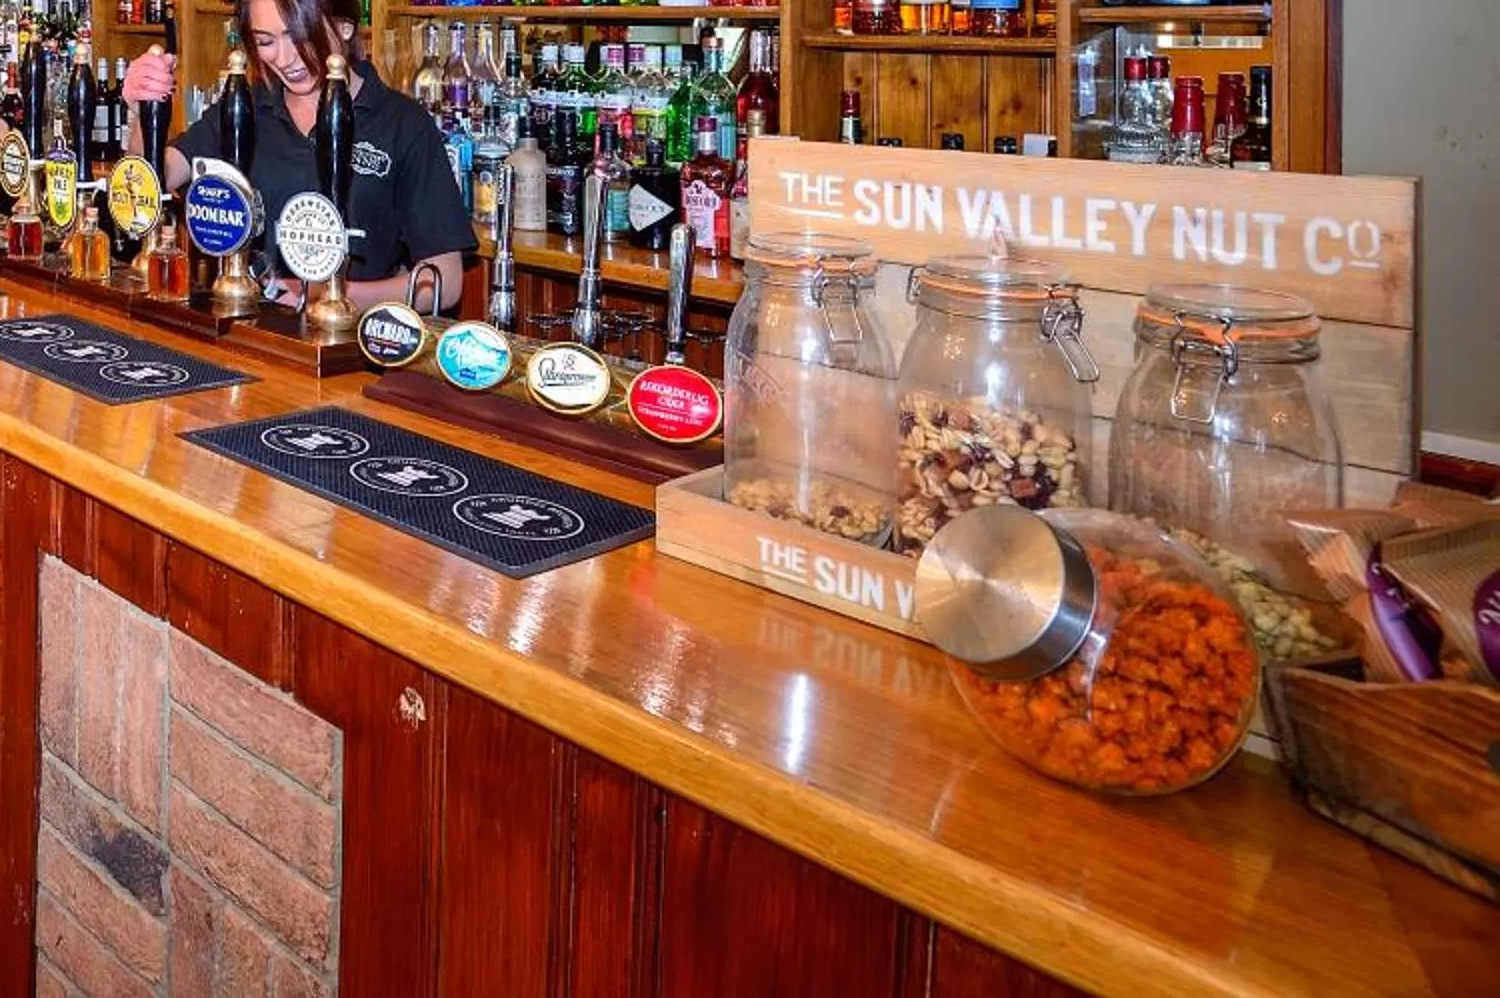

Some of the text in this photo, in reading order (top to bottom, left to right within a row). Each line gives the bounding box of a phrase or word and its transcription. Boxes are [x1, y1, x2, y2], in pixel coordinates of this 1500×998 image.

[188, 202, 245, 227] DOOM BAR
[279, 229, 342, 246] HOPHEAD
[778, 171, 845, 206] THE
[852, 178, 946, 235] SUN
[956, 186, 1157, 256] VALLEY
[1171, 204, 1286, 270] NUT
[755, 535, 807, 573] THE
[813, 555, 885, 612] SUN
